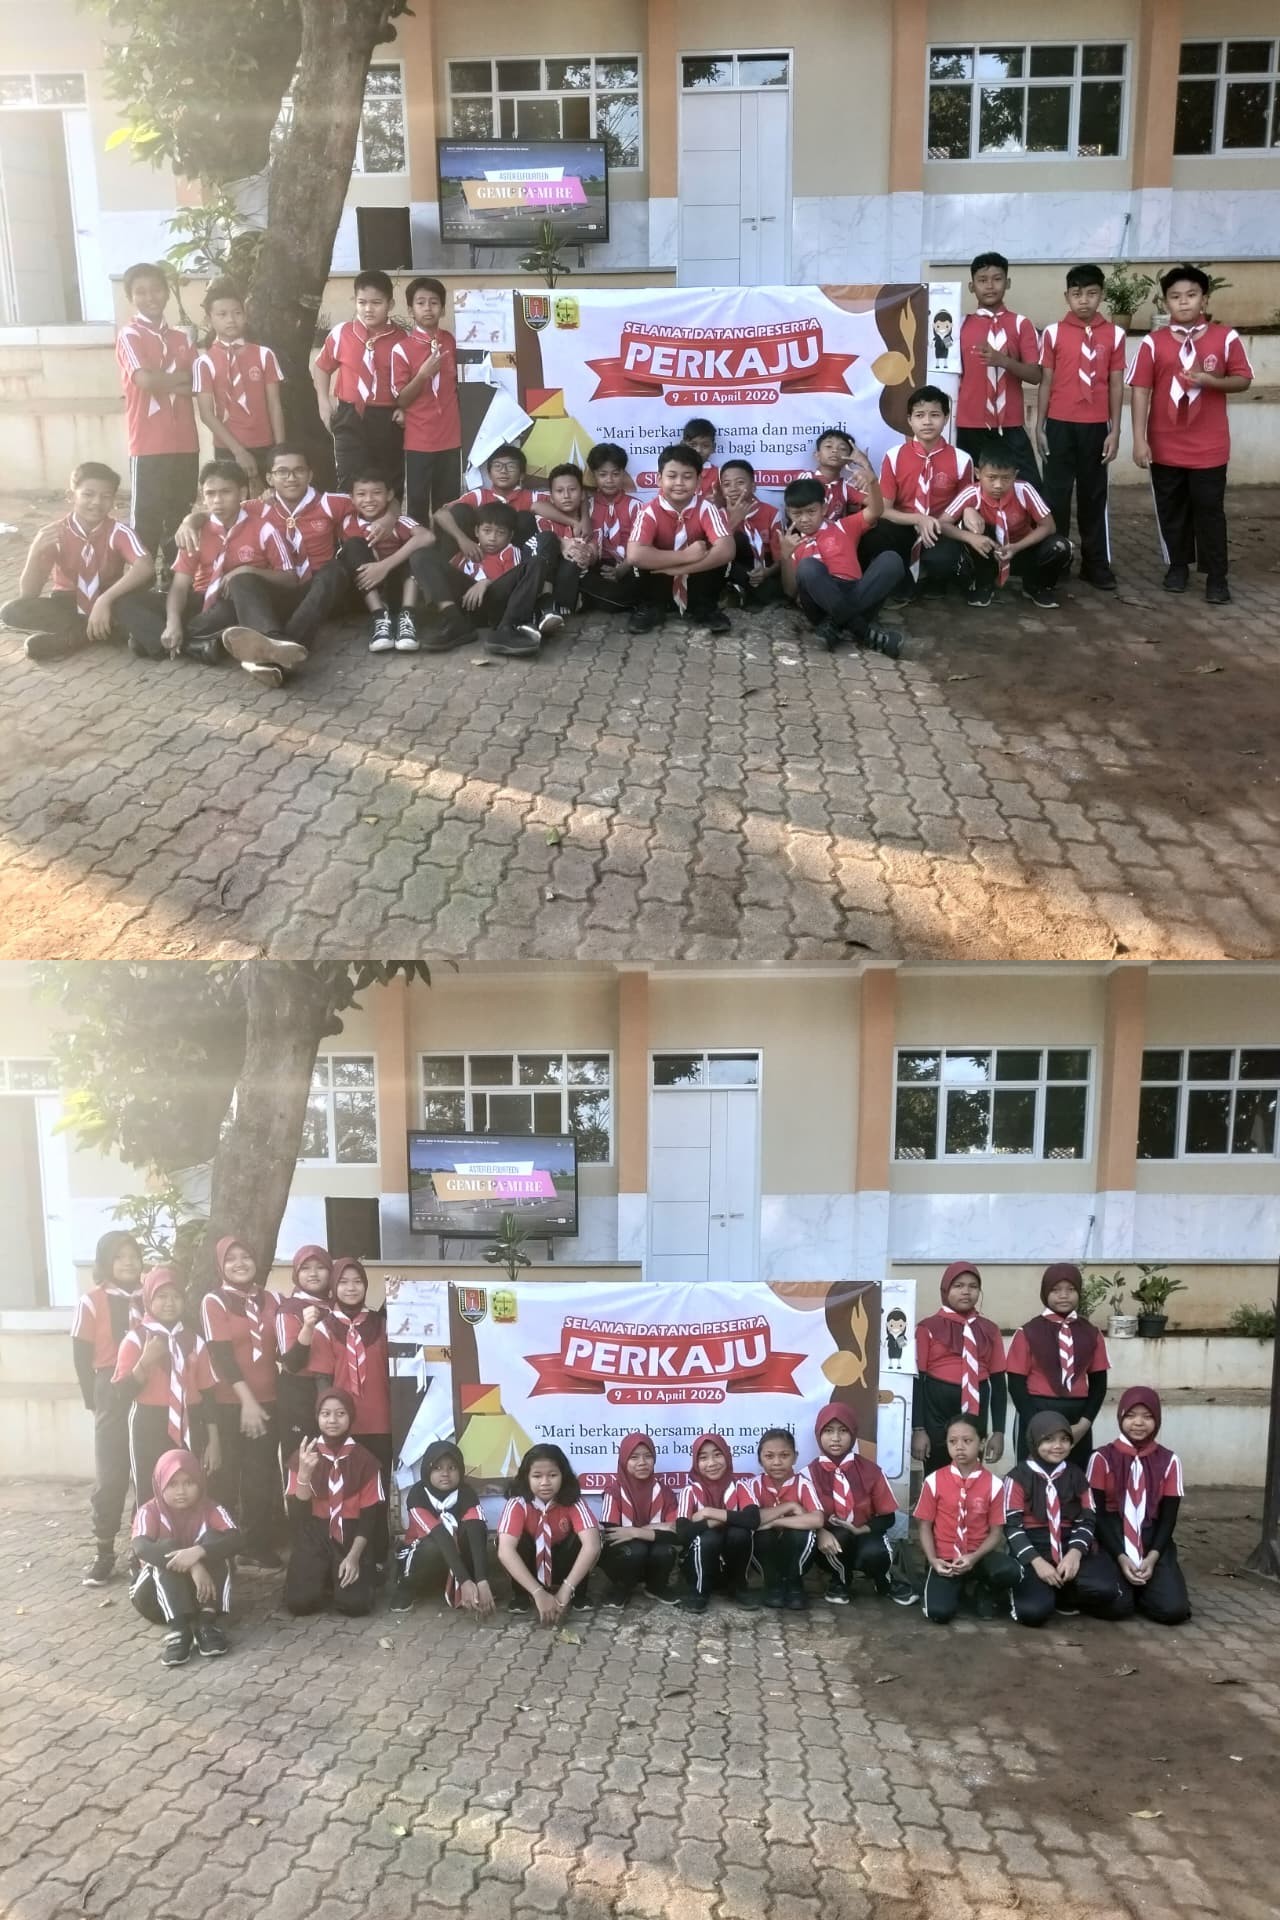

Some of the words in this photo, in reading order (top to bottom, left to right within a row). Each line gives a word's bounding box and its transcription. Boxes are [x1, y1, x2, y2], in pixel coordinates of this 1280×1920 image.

[623, 321, 692, 340] SELAMAT
[693, 326, 756, 341] DATANG
[757, 317, 821, 337] PESERTA
[624, 335, 820, 379] PERKAJU
[672, 392, 679, 403] 9
[692, 391, 708, 402] 10
[712, 390, 741, 404] April
[745, 390, 776, 401] 2026
[639, 425, 685, 438] berkar
[714, 426, 758, 437] rsama
[762, 422, 788, 436] dan
[629, 442, 665, 455] insan
[728, 439, 756, 456] bagi
[754, 468, 780, 484] ulon
[564, 1316, 637, 1335] SELAMAT
[637, 1322, 701, 1336] DATANG
[703, 1315, 768, 1334] PESERTA
[564, 1334, 767, 1377] PERKAJU
[614, 1390, 622, 1401] 9
[636, 1390, 652, 1401] 10
[656, 1389, 686, 1403] April
[690, 1389, 722, 1401] 2026
[645, 1423, 703, 1437] bersama
[708, 1423, 735, 1437] dan
[738, 1423, 796, 1437] mendi
[569, 1441, 608, 1455] insan
[585, 1474, 607, 1487] SD
